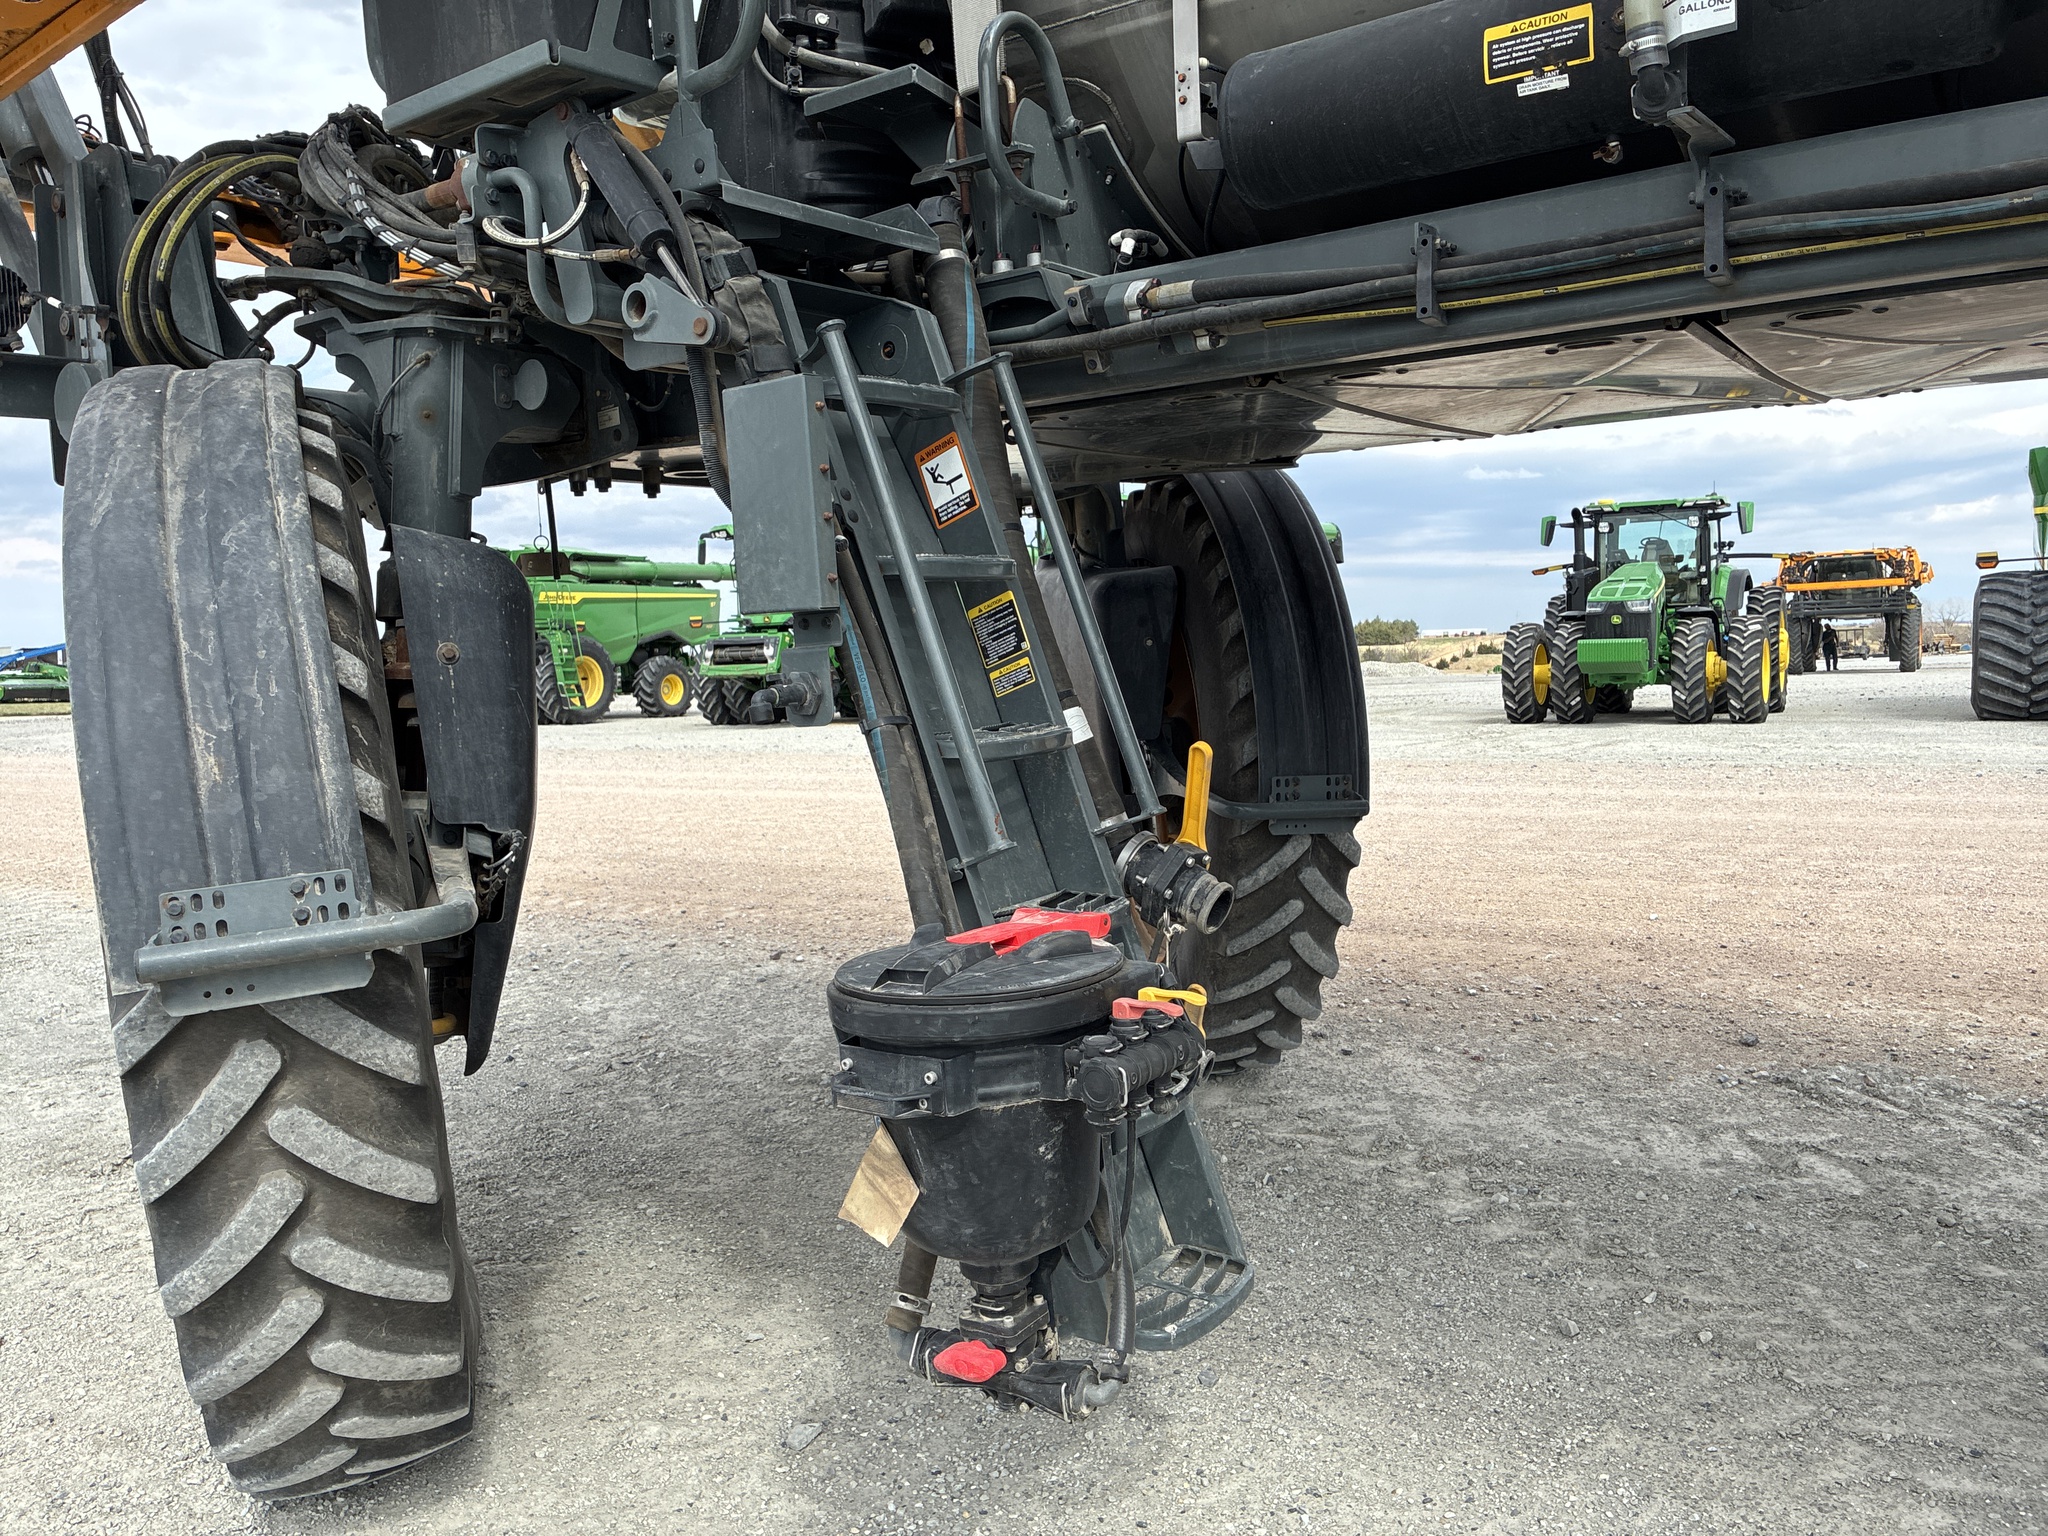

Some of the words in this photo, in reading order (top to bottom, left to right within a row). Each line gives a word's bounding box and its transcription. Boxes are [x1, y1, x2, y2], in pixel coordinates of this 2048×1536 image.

[1519, 12, 1568, 31] CAUTION
[1532, 31, 1552, 41] pressure
[1562, 23, 1585, 33] discharge
[1513, 41, 1542, 51] components.
[1555, 32, 1578, 41] protective
[1524, 70, 1560, 82] IMPTANT
[925, 436, 955, 458] WARNING
[983, 597, 1003, 610] CAUTION
[853, 652, 866, 682] VERSIFLO
[1003, 662, 1021, 673] CAUTION
